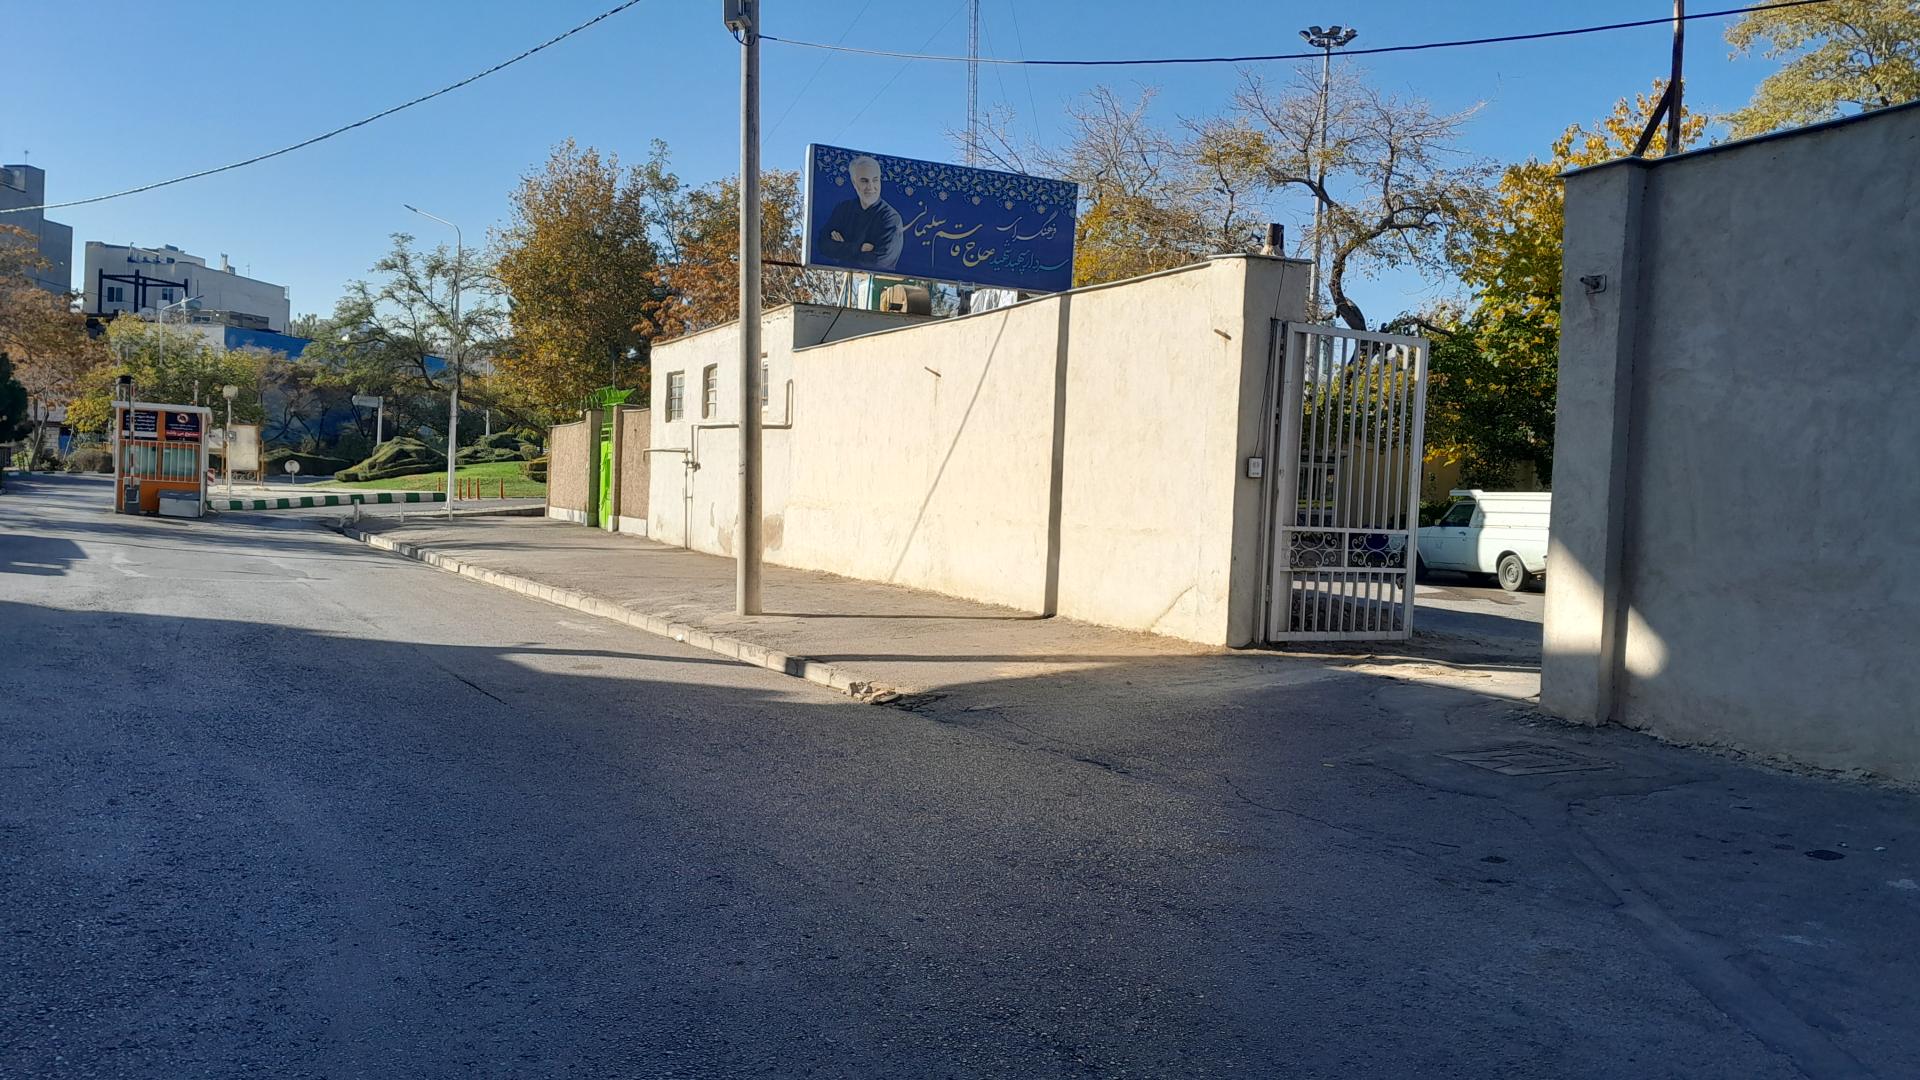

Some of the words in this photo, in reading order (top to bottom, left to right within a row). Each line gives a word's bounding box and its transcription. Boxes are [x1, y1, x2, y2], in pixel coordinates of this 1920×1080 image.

[902, 201, 947, 246] سلیمانی
[931, 223, 983, 268] قاسم
[962, 241, 996, 268] حاج
[989, 240, 1013, 271] شهید
[1023, 252, 1069, 272] سردار
